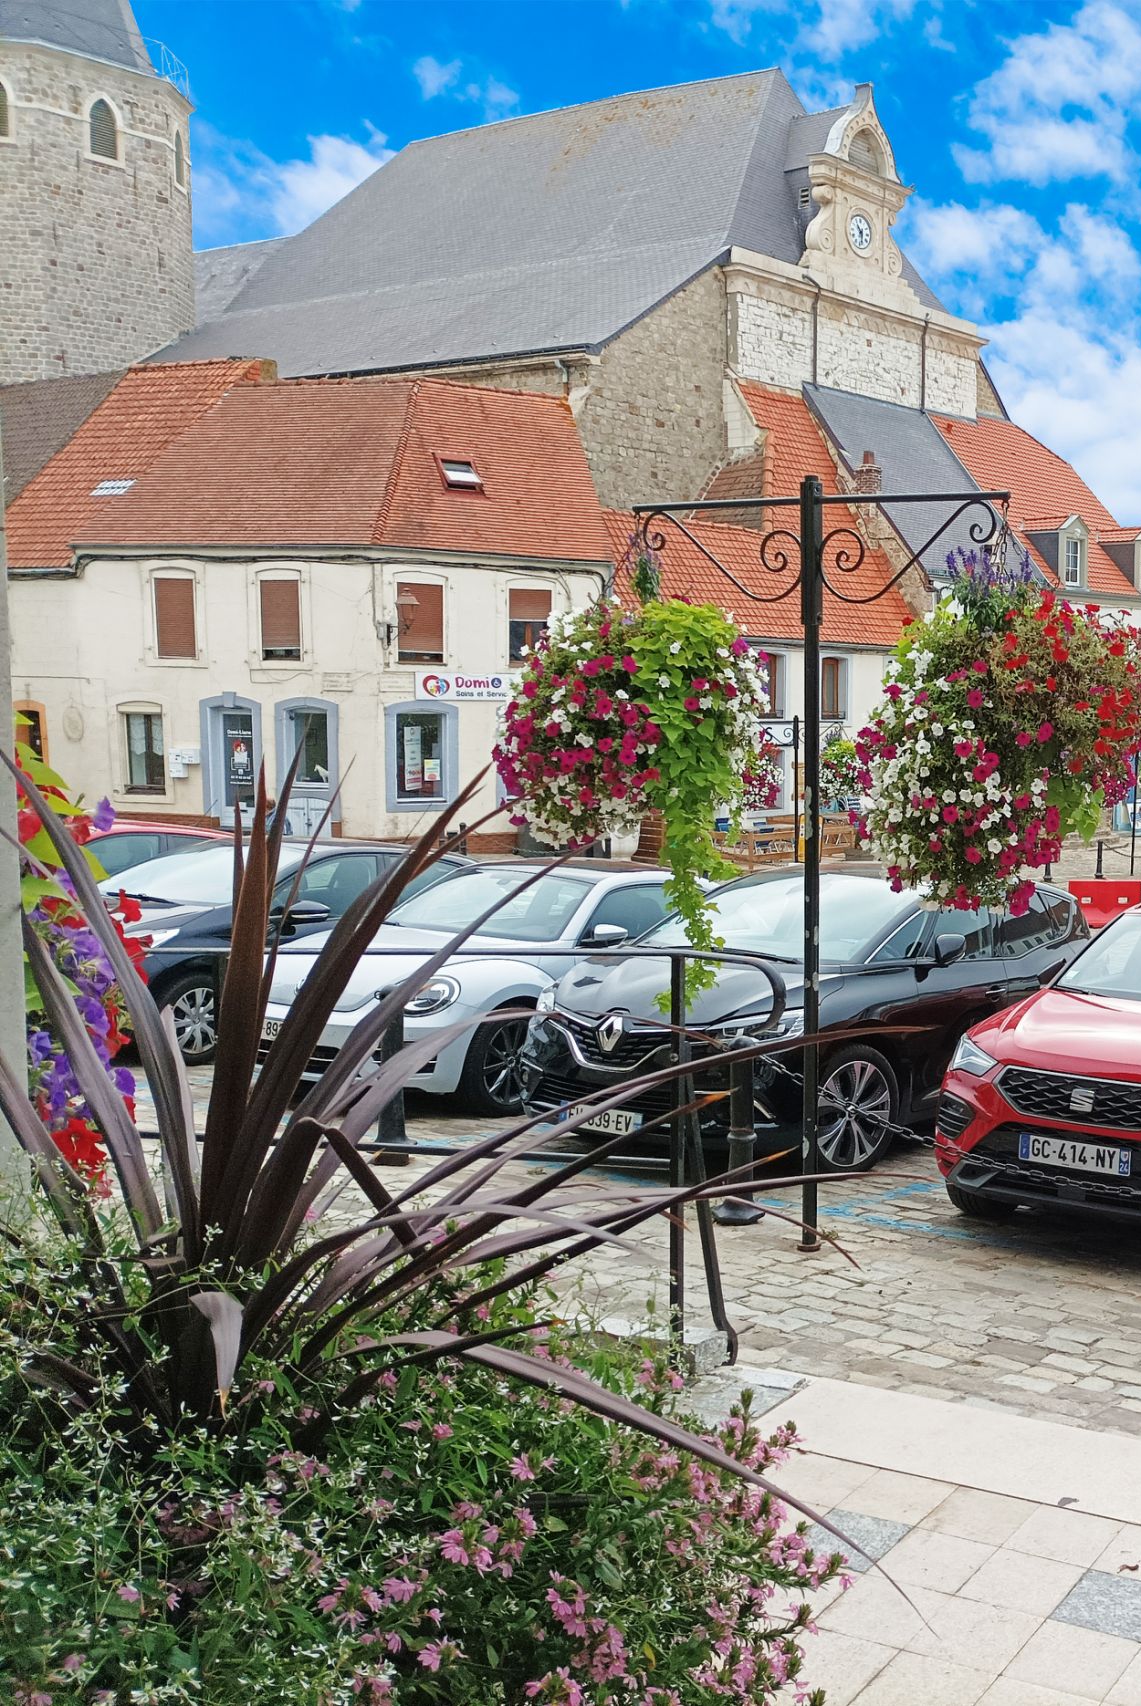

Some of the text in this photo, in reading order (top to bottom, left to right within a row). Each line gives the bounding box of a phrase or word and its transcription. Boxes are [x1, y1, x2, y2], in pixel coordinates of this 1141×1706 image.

[455, 677, 489, 688] Domi
[487, 690, 508, 698] Servic
[1031, 1138, 1117, 1169] GC-414-NY
